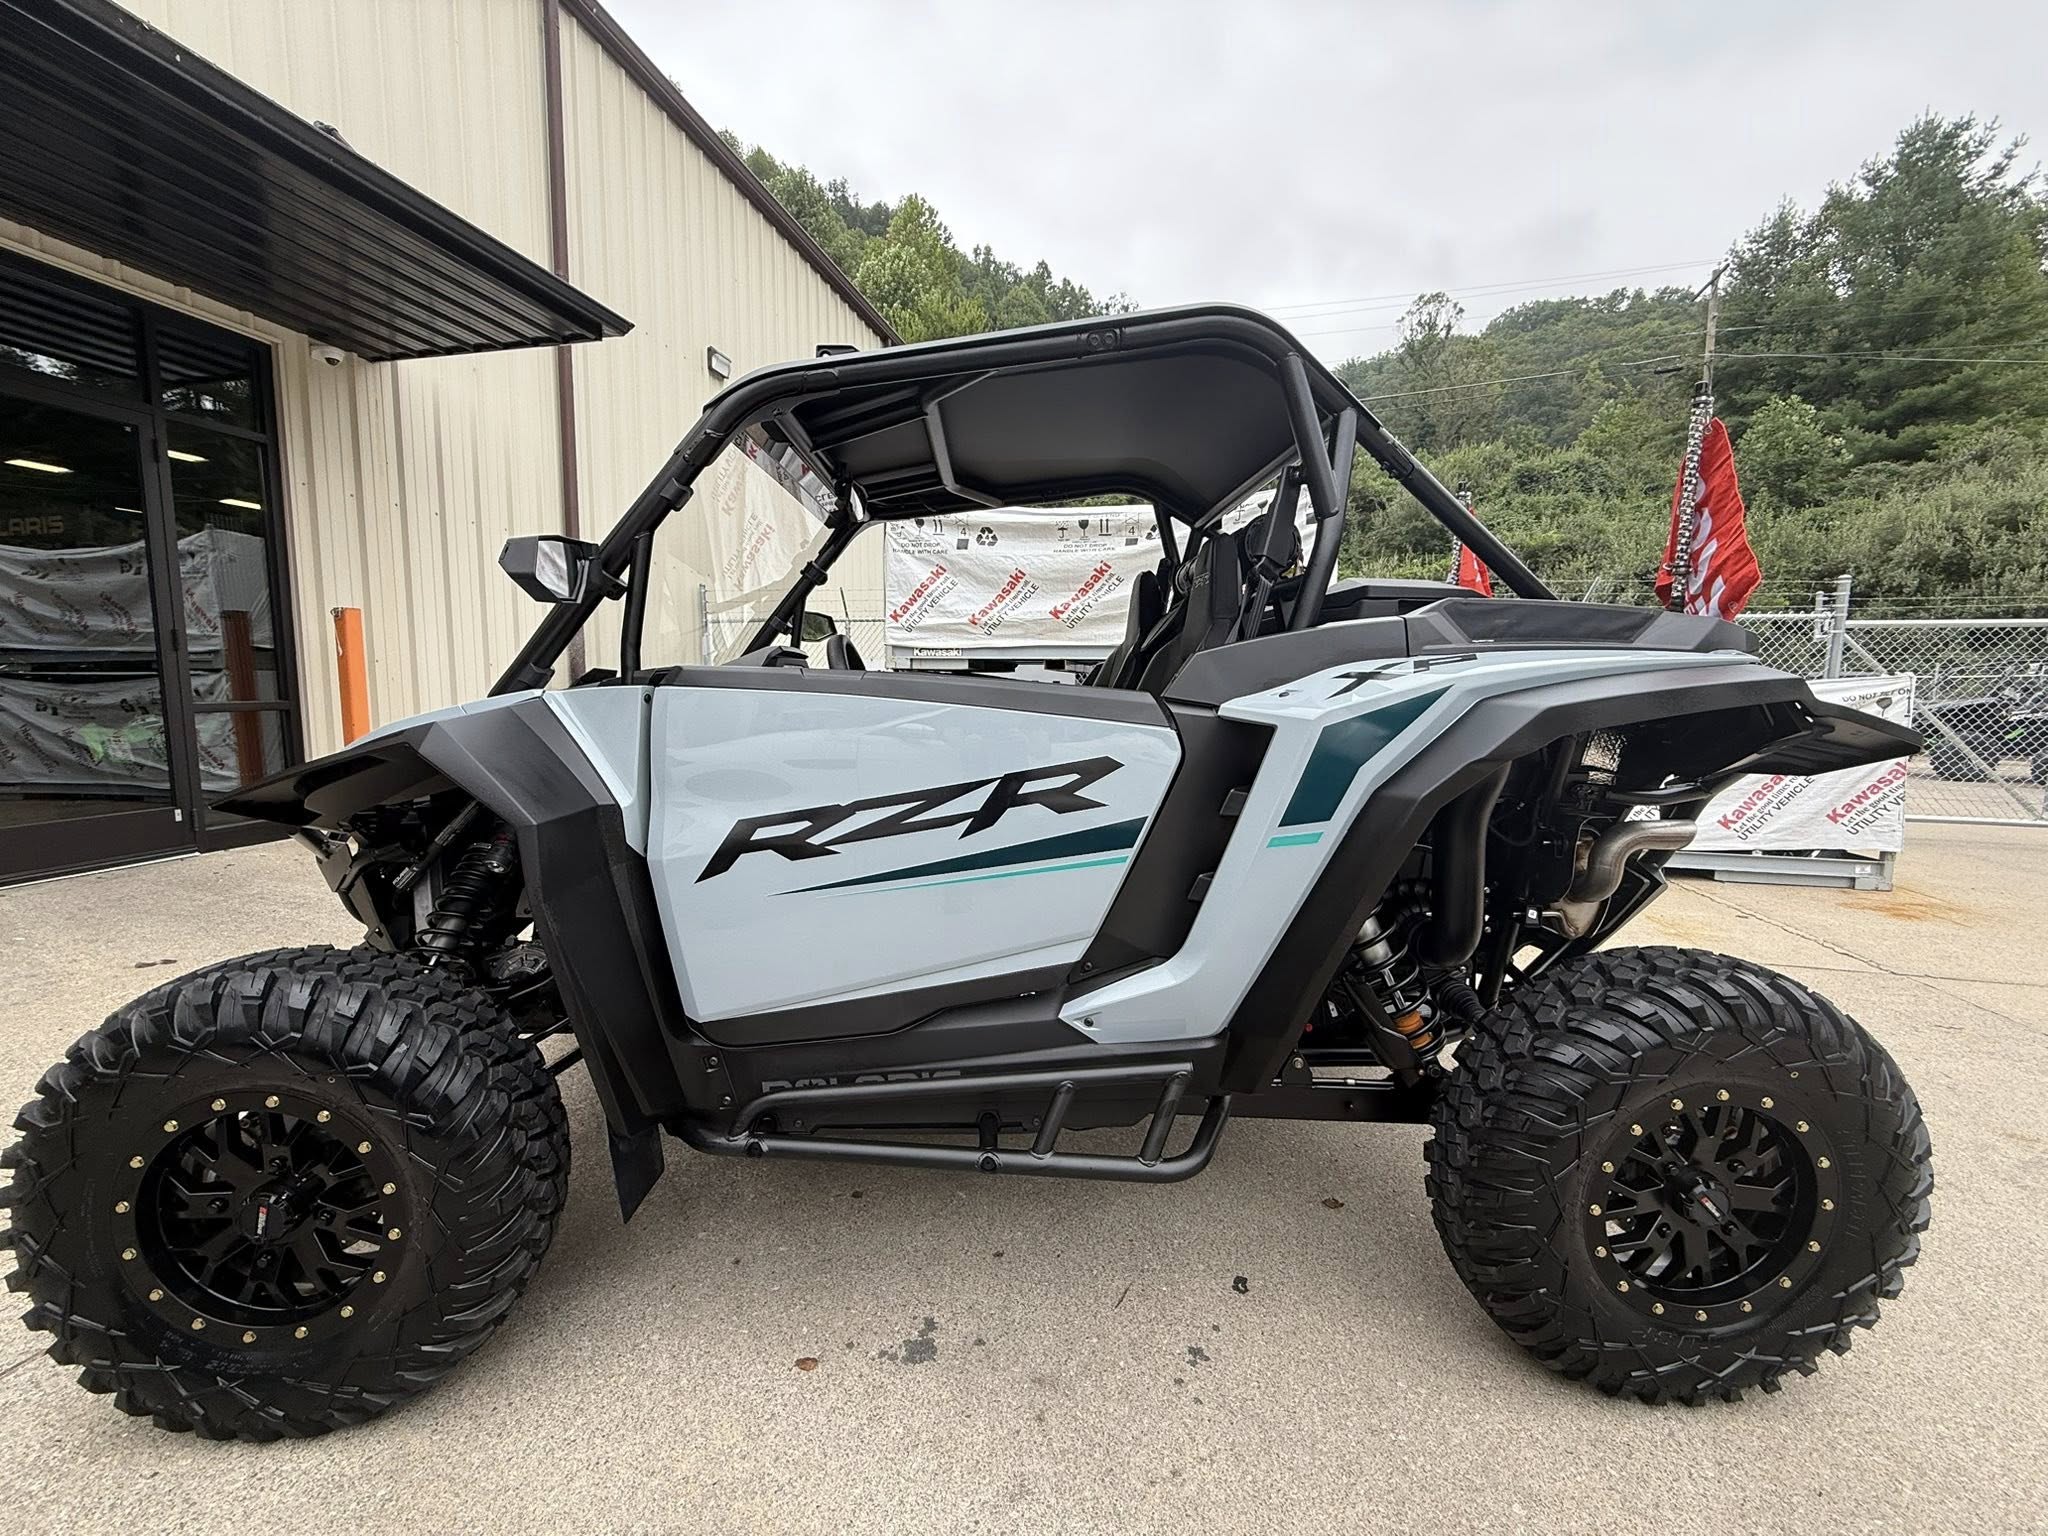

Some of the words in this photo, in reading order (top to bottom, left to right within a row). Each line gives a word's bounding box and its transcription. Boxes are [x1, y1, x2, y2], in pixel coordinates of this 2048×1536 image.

[889, 563, 947, 623] Kawasaki
[904, 608, 929, 633] UTILITY
[927, 580, 959, 609] VEHICLE
[968, 567, 1026, 625] Kawasaki
[984, 611, 1009, 636] UTILITY
[1008, 583, 1039, 611] VEHICLE
[1048, 560, 1112, 620] Kawasaki
[1066, 602, 1093, 629] UTILITY
[1091, 576, 1125, 602] VEHICLE
[913, 648, 962, 657] Kawasaki
[694, 755, 1124, 884] RZR
[1717, 774, 1788, 830] Kawasa
[1733, 822, 1747, 833] Let
[1745, 813, 1758, 823] the
[1757, 798, 1774, 814] good
[1772, 783, 1791, 800] times
[1737, 809, 1774, 841] UTILITY
[1772, 776, 1815, 811] VEHICLE
[1841, 816, 1856, 827] Let
[1855, 806, 1870, 818] the
[1869, 792, 1890, 809] good
[1846, 804, 1891, 835] UTILITY
